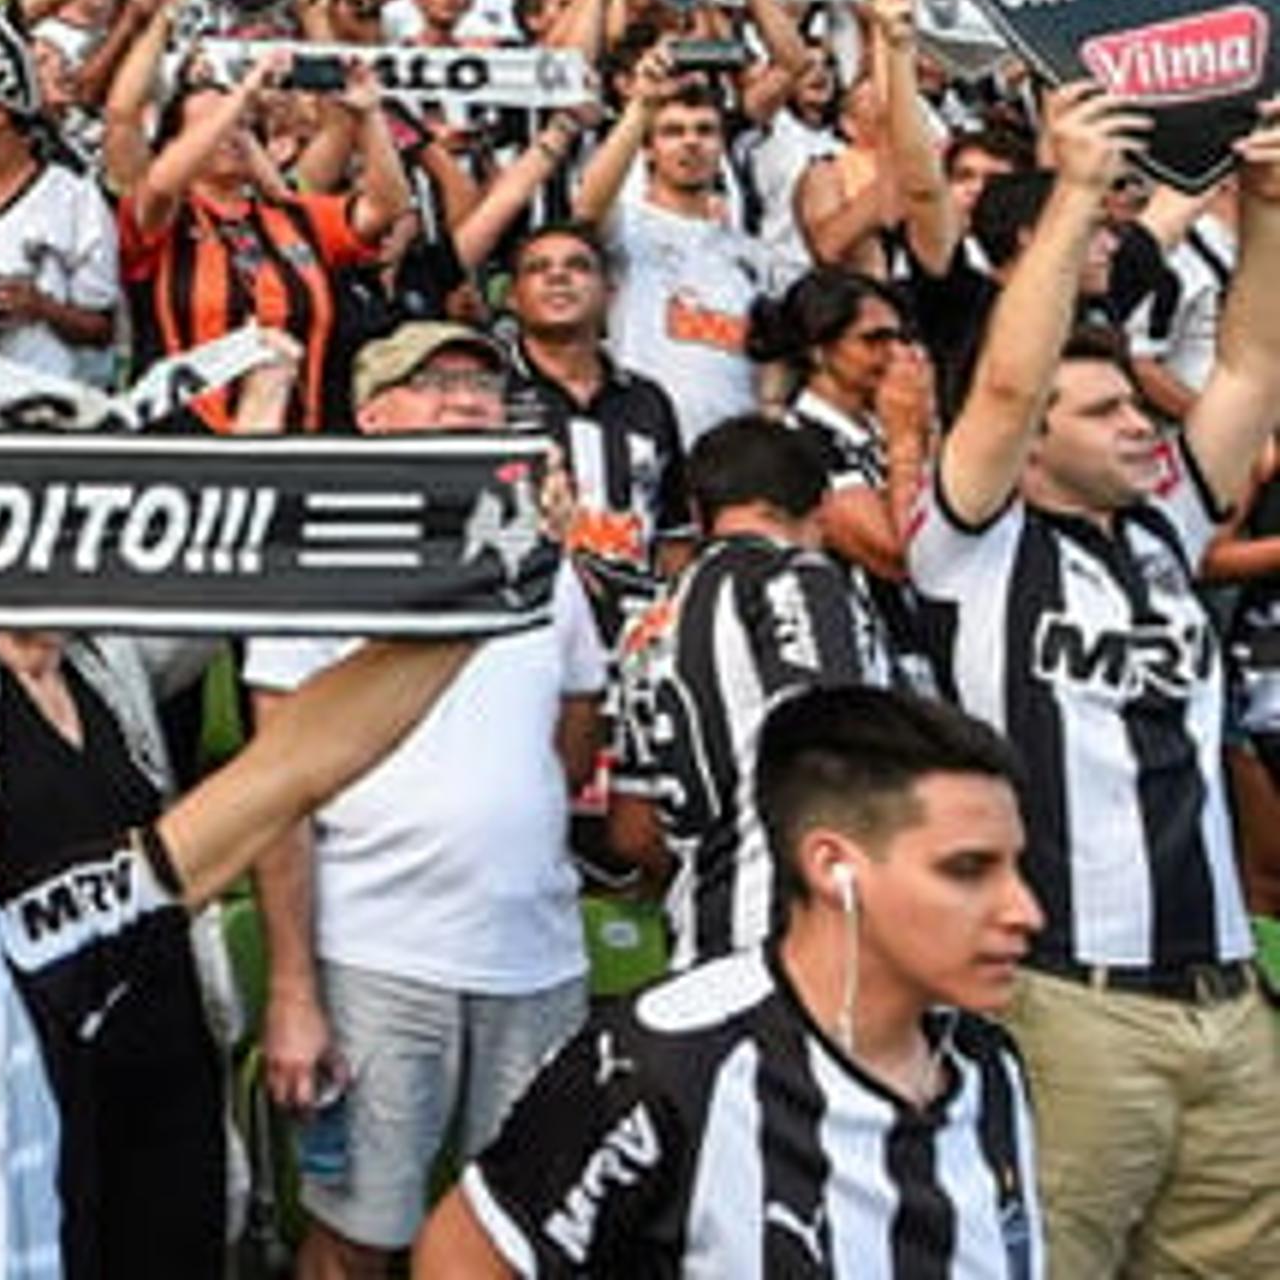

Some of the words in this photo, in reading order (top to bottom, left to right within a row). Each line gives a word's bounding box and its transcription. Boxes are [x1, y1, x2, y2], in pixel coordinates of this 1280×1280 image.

[1097, 30, 1252, 90] Vilma
[18, 855, 137, 943] MRV
[543, 1104, 662, 1264] MRV
